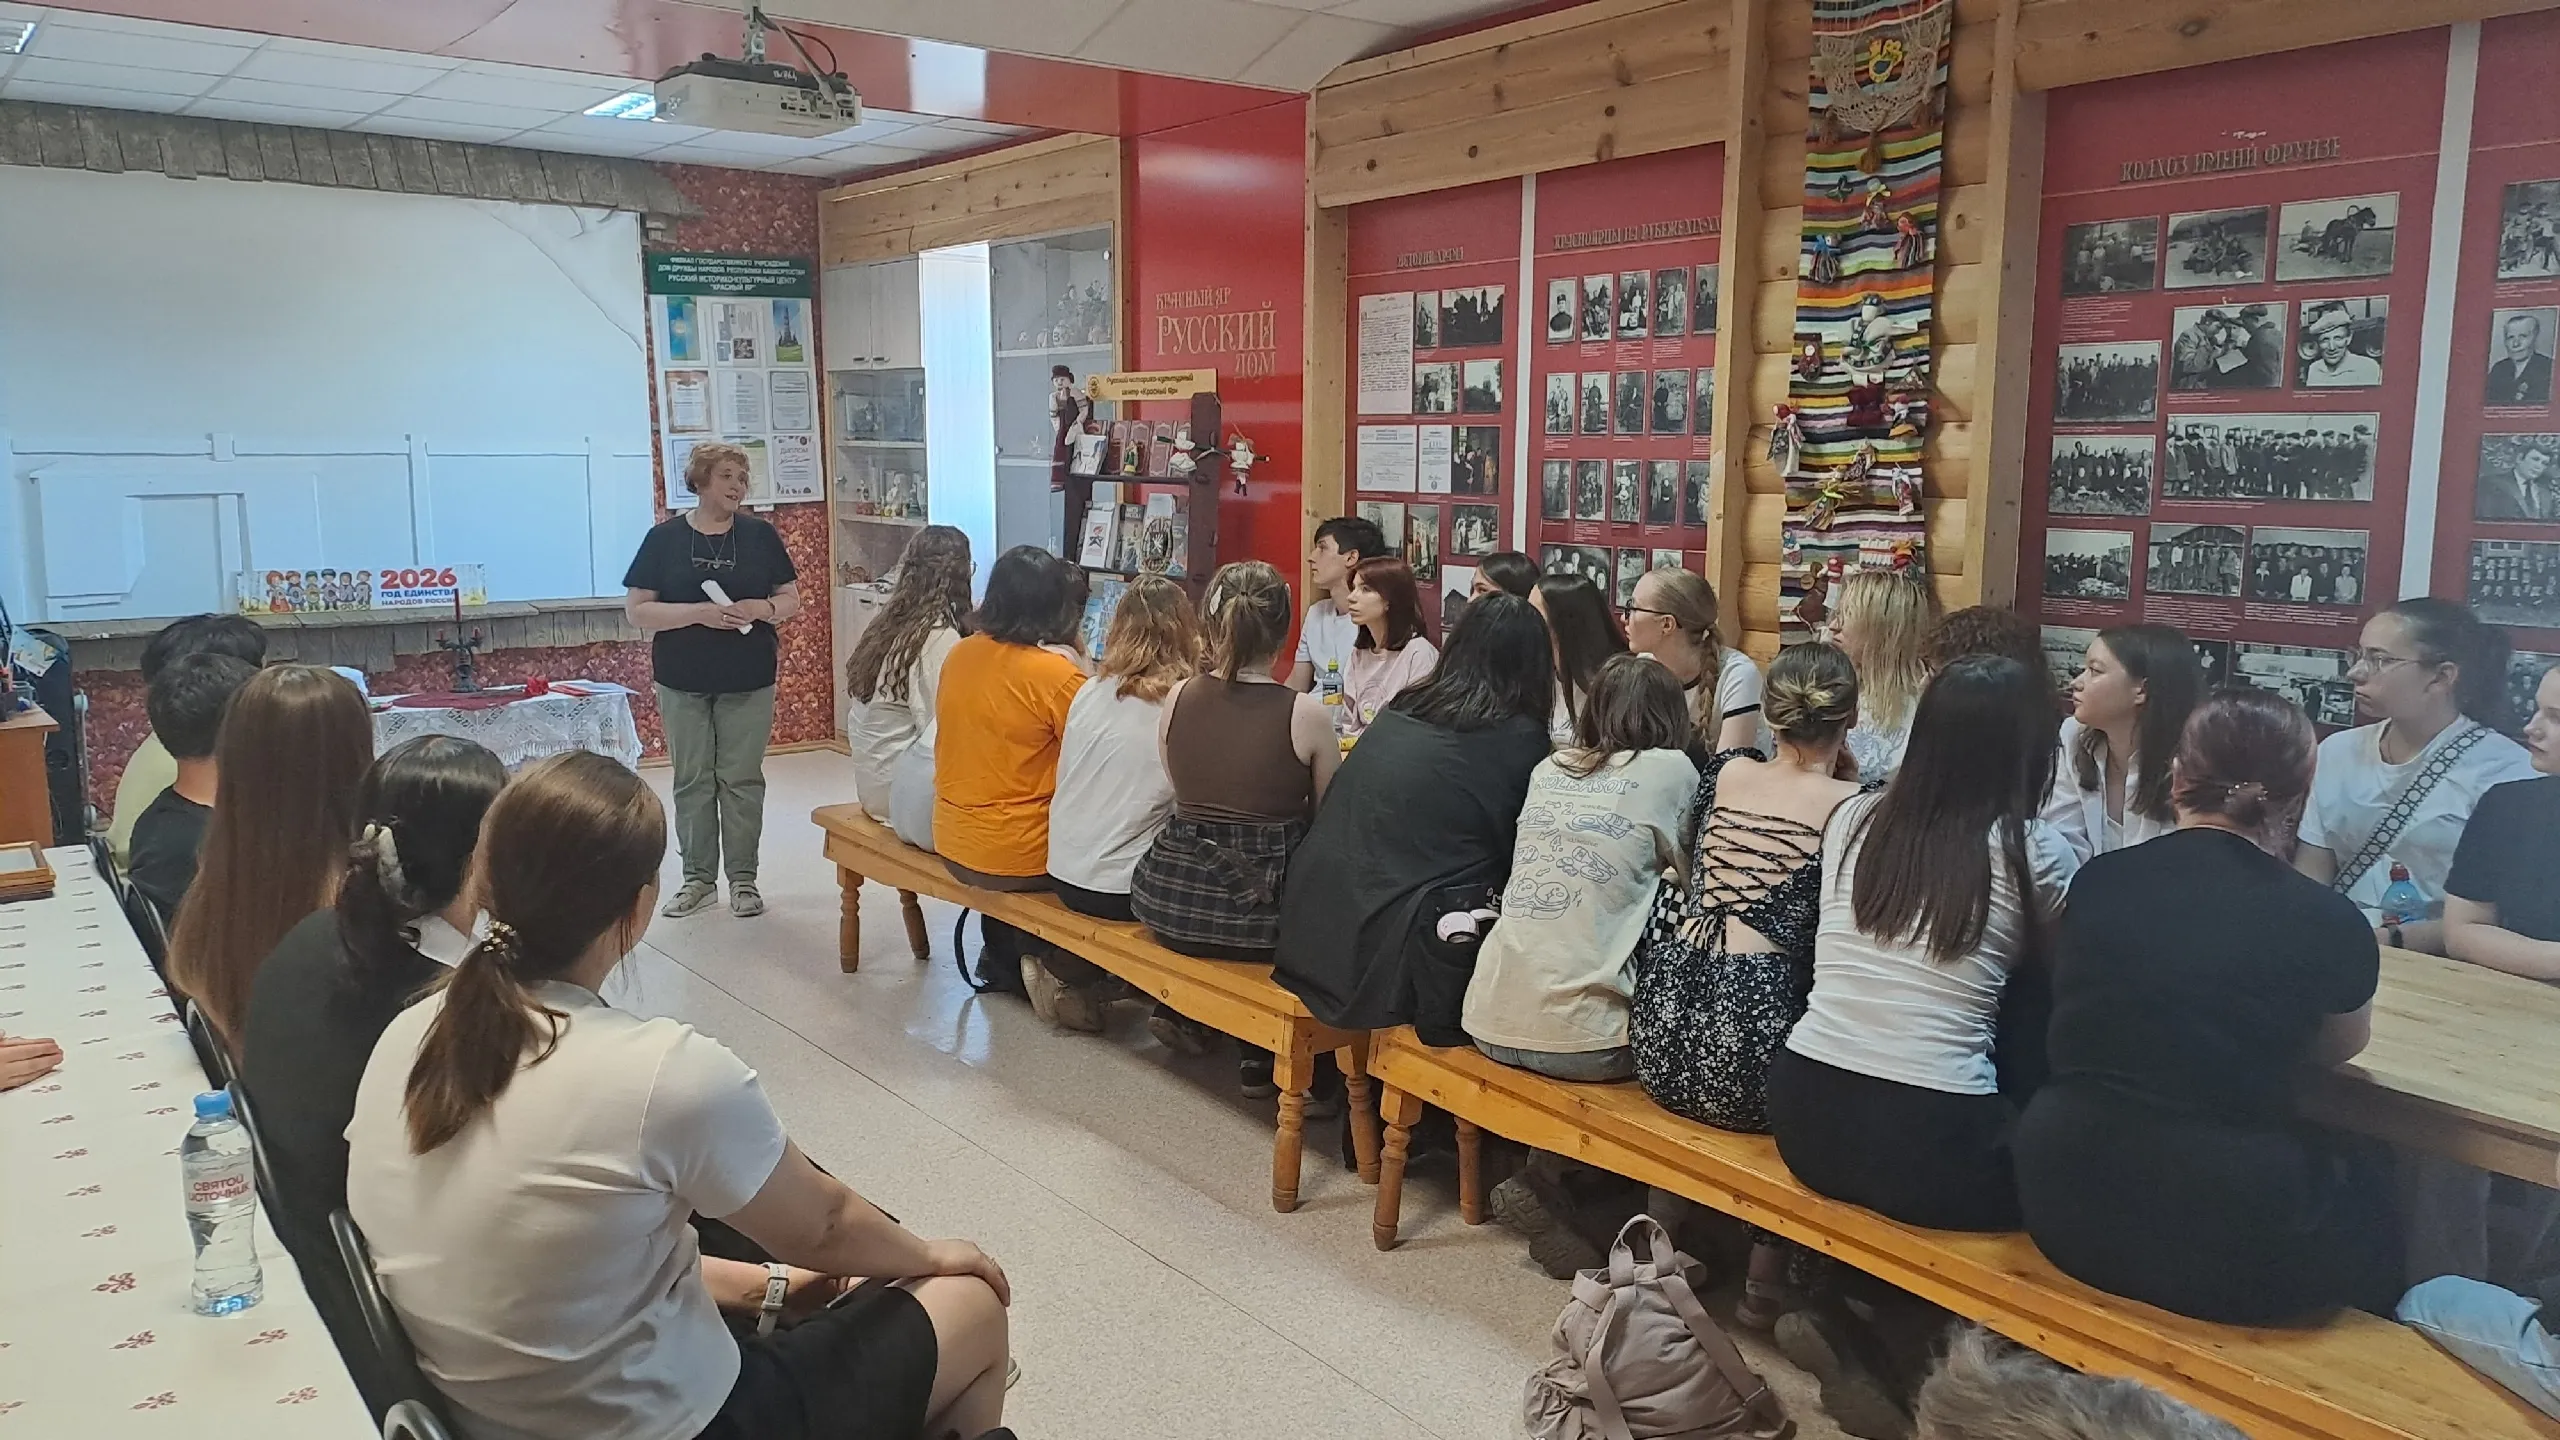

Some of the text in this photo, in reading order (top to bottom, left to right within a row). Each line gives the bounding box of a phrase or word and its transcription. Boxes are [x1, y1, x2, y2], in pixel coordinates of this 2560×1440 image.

[2192, 146, 2258, 174] ИМЕНИ
[2264, 136, 2341, 165] ФРУНЗЕ
[668, 274, 698, 283] РУССКИЙ
[1156, 285, 1214, 312] КРАСНЫЙ
[1156, 300, 1276, 356] РУССКИЙ
[1234, 351, 1276, 384] ДОМ
[380, 567, 457, 590] 2026
[381, 590, 402, 598] ГОД
[1561, 801, 1577, 816] 2.
[1549, 834, 1564, 852] 4.
